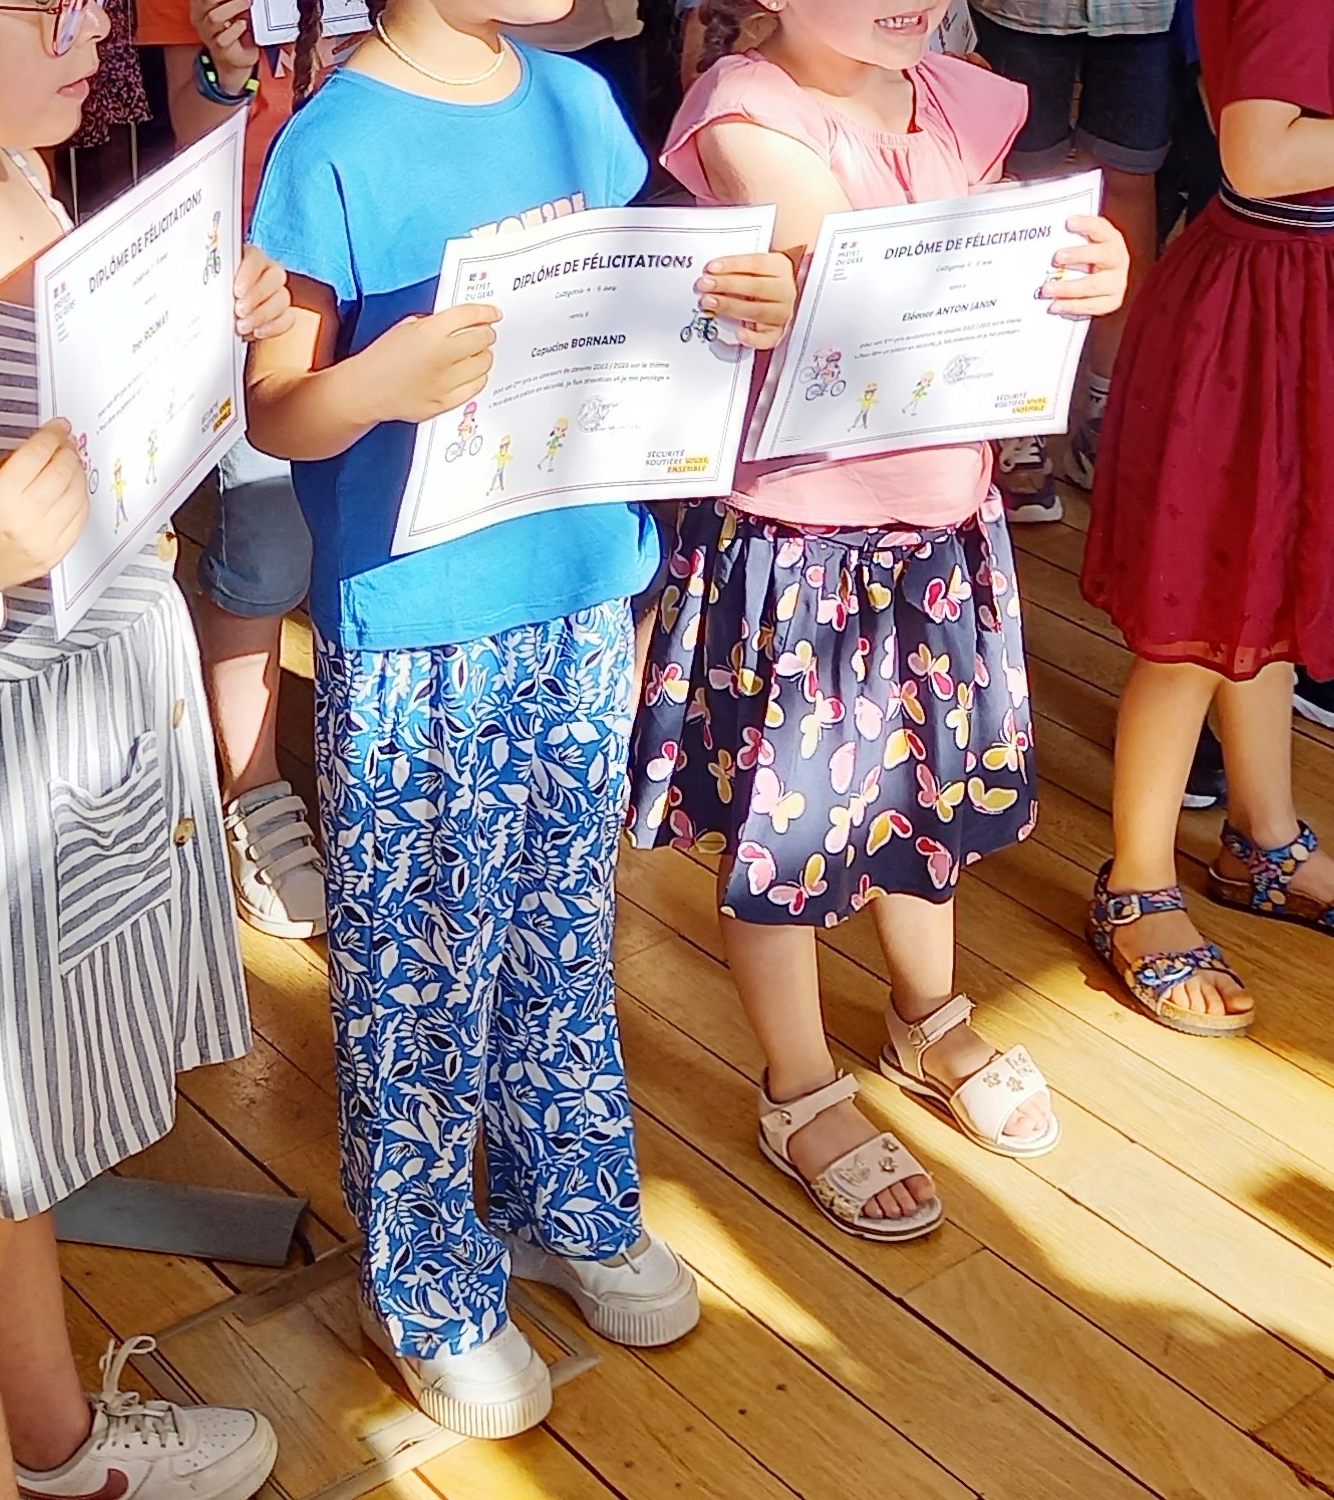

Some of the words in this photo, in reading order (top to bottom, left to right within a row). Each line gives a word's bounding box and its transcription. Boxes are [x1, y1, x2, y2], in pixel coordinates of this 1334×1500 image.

[88, 248, 129, 294] DIPLÔME
[131, 236, 143, 260] DE
[144, 188, 202, 250] FÉLICITATIONS
[884, 240, 942, 260] DIPLÔME
[944, 238, 962, 252] DE
[964, 224, 1052, 250] FÉLICITATIONS
[512, 264, 566, 292] DIPLÔME
[566, 258, 580, 274] DE
[582, 252, 694, 272] FÉLICITATIONS
[936, 304, 968, 316] ANTON
[531, 341, 569, 359] Capucine
[570, 334, 626, 349] BORNAND
